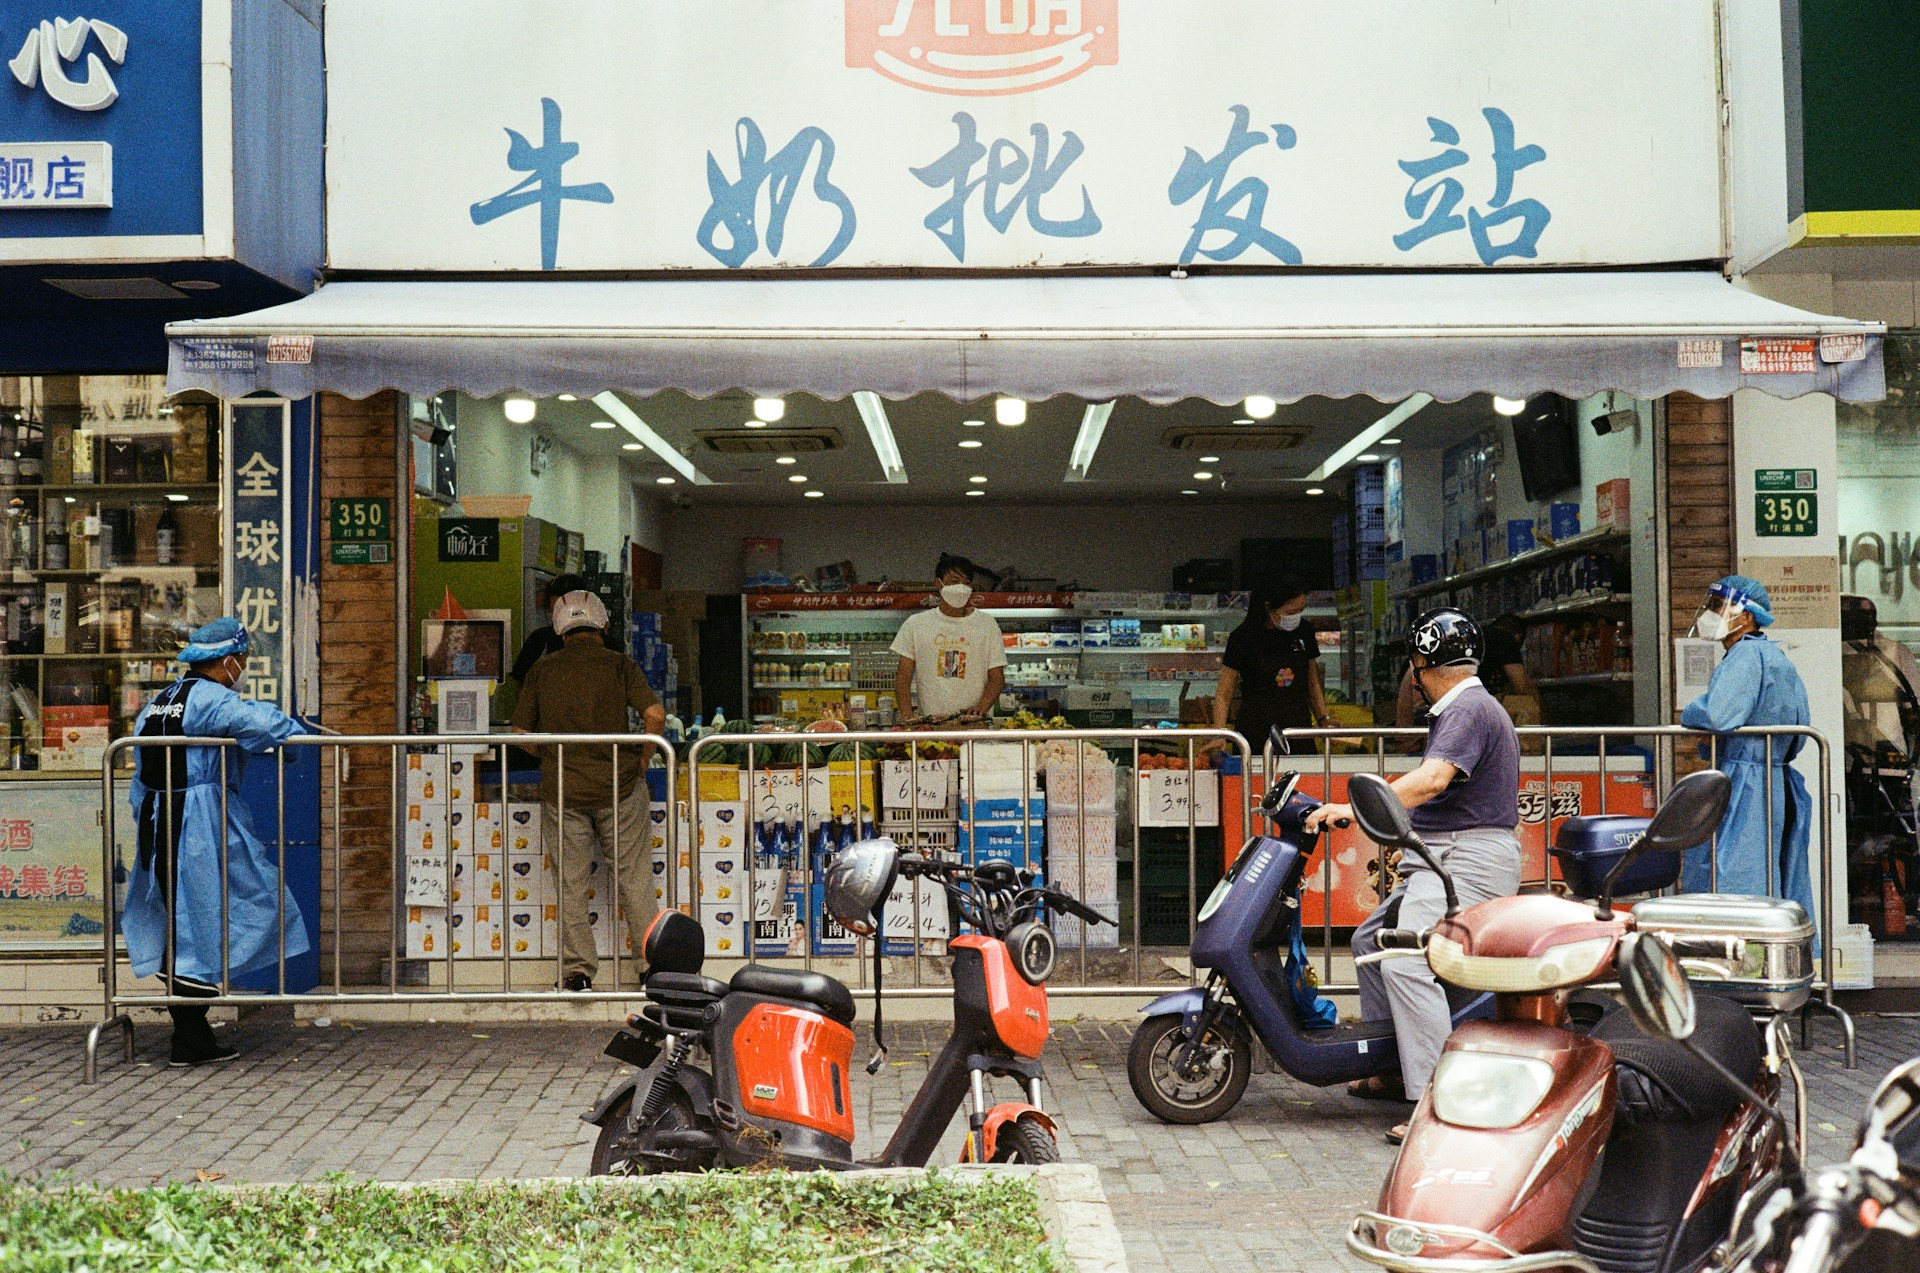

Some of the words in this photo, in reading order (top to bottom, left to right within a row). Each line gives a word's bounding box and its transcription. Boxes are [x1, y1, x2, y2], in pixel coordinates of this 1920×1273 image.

[8, 16, 128, 111] 心
[470, 97, 1551, 270] 牛奶批发站
[1767, 352, 1790, 361] 2184
[1791, 352, 1813, 361] 9284
[1768, 362, 1790, 371] 8197
[1791, 362, 1814, 371] 9928
[338, 503, 382, 526] 350
[1764, 498, 1809, 521] 350
[236, 451, 281, 701] 全球优品
[0, 818, 33, 850] 酒
